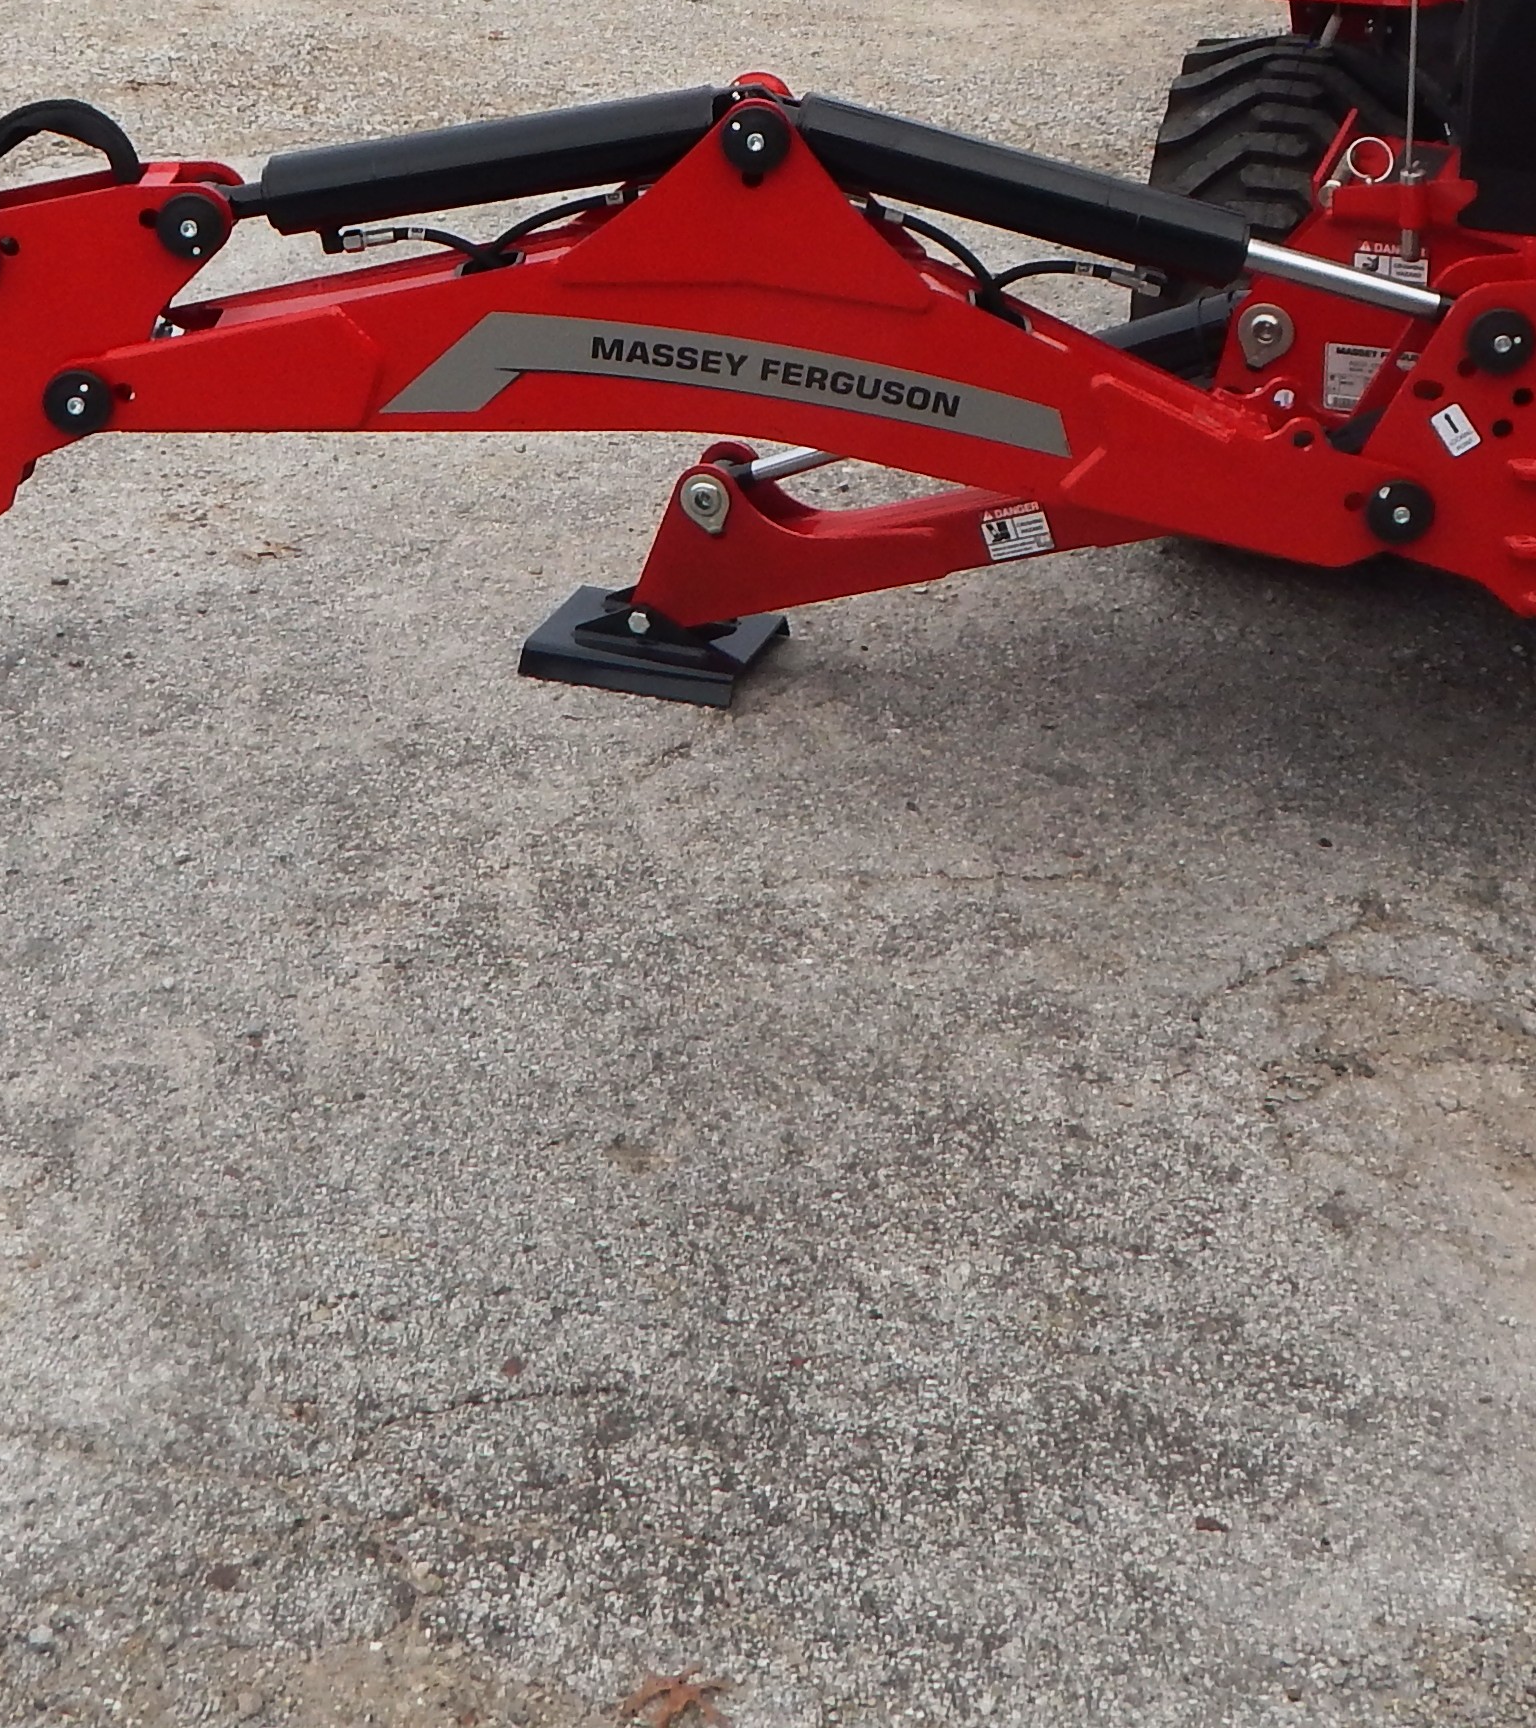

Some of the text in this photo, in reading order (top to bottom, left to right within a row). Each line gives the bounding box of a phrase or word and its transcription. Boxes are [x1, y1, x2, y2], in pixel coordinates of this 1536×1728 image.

[591, 336, 962, 418] MASSEY FERGUSON
[993, 501, 1040, 519] DANGER
